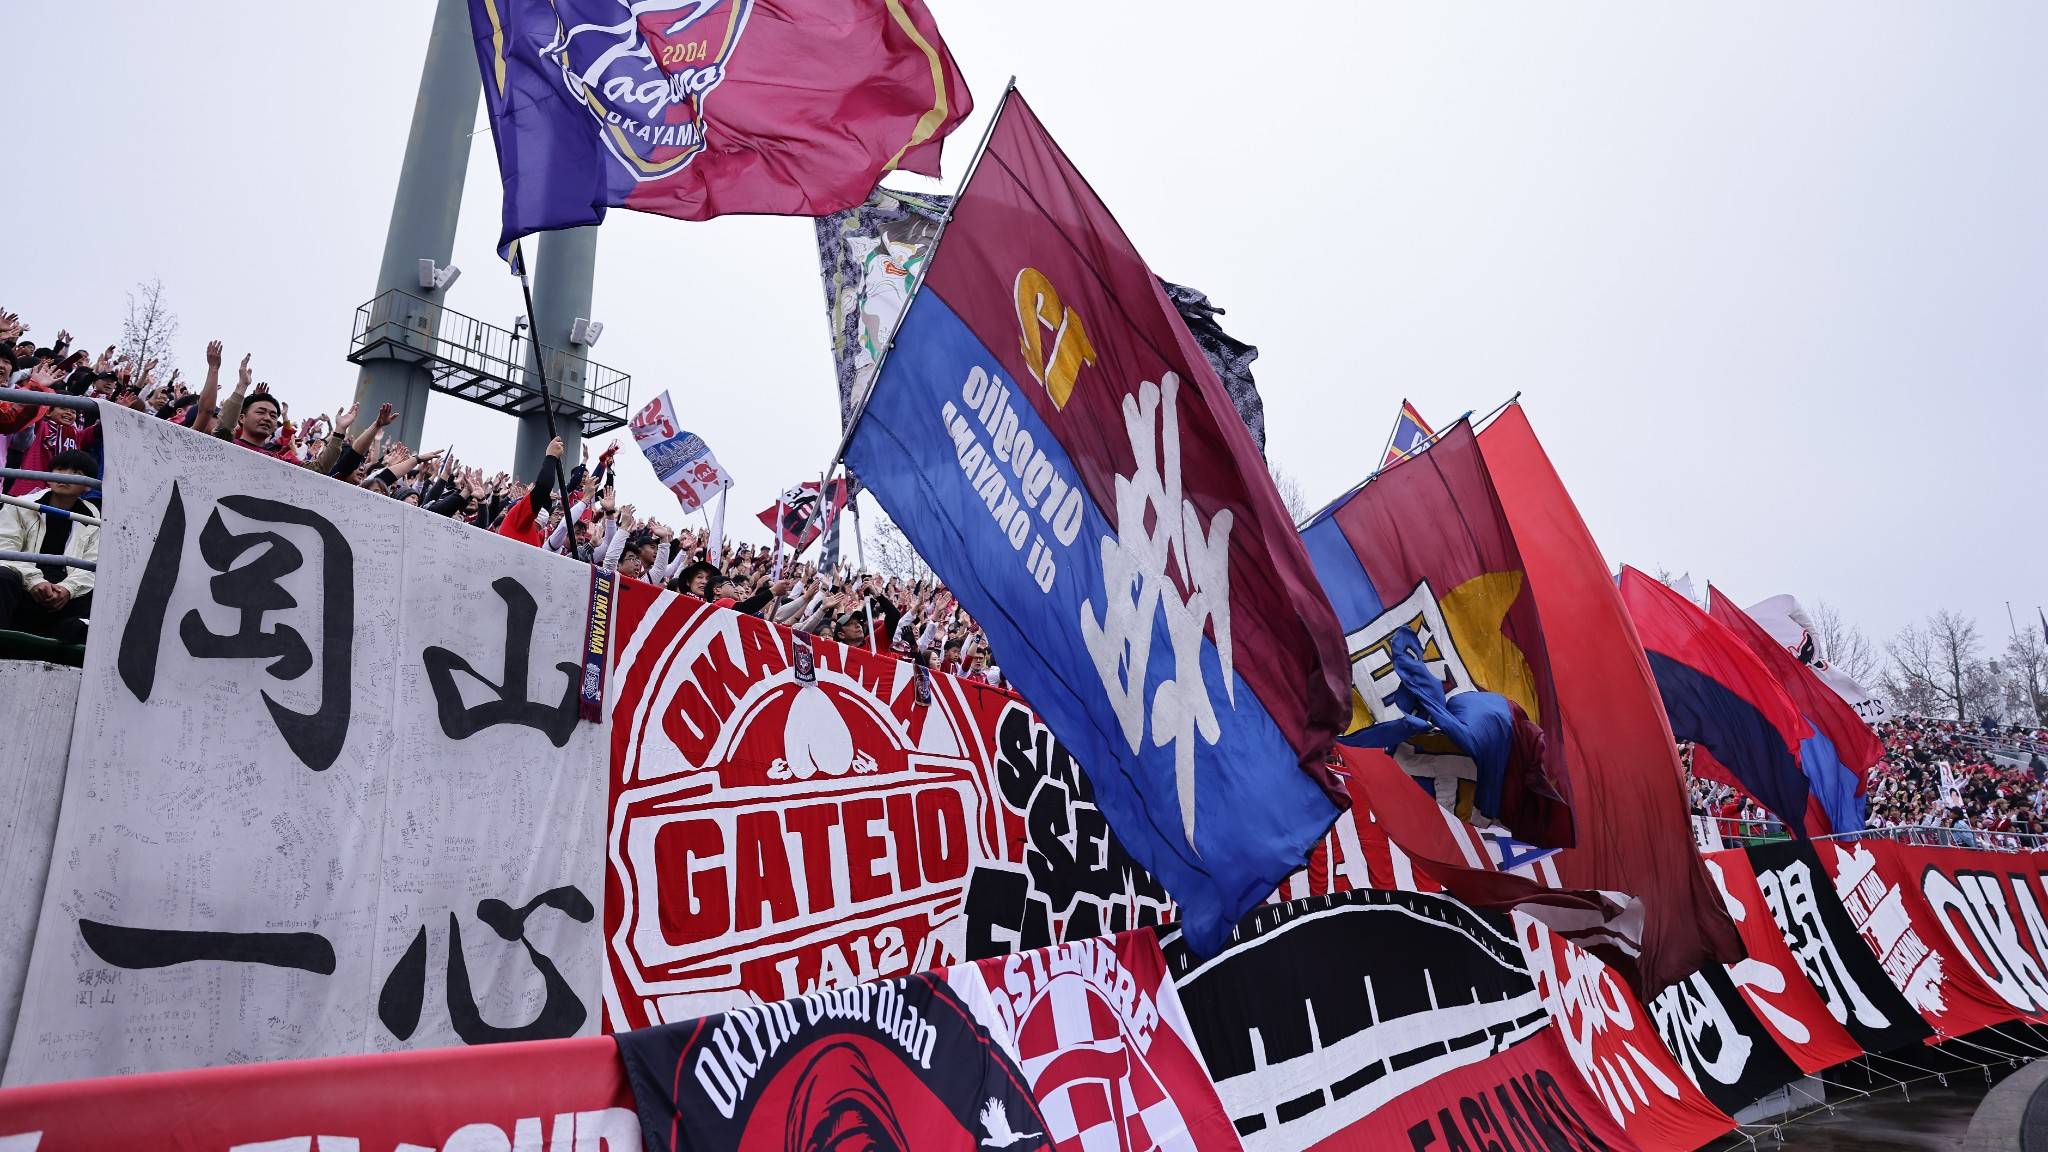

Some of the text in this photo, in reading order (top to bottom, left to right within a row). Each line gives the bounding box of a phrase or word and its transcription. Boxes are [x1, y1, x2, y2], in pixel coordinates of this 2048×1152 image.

[662, 40, 708, 66] 2004
[598, 577, 610, 595] DI
[590, 597, 609, 655] OKAYAMA
[661, 613, 931, 769] OKAAMA
[1861, 926, 1884, 961] OF
